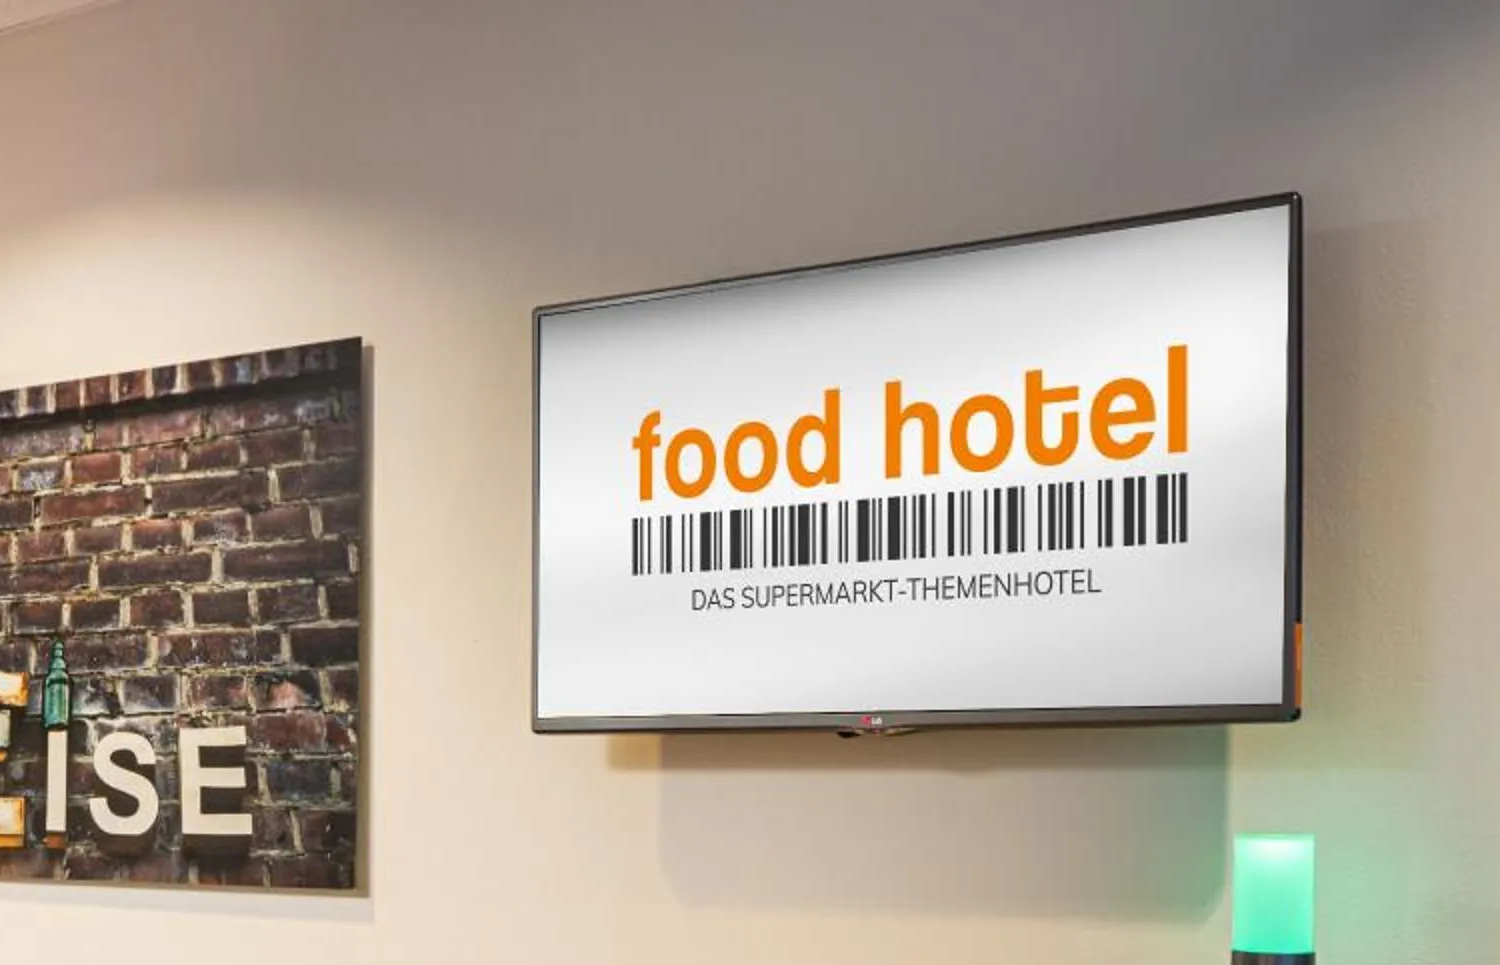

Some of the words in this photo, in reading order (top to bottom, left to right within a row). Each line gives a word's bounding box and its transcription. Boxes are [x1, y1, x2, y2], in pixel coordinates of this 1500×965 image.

[632, 388, 840, 500] food
[884, 344, 1188, 478] hotel
[691, 588, 736, 611] DAS
[741, 569, 1102, 609] SUPERMARKT-THEMENHOTEL
